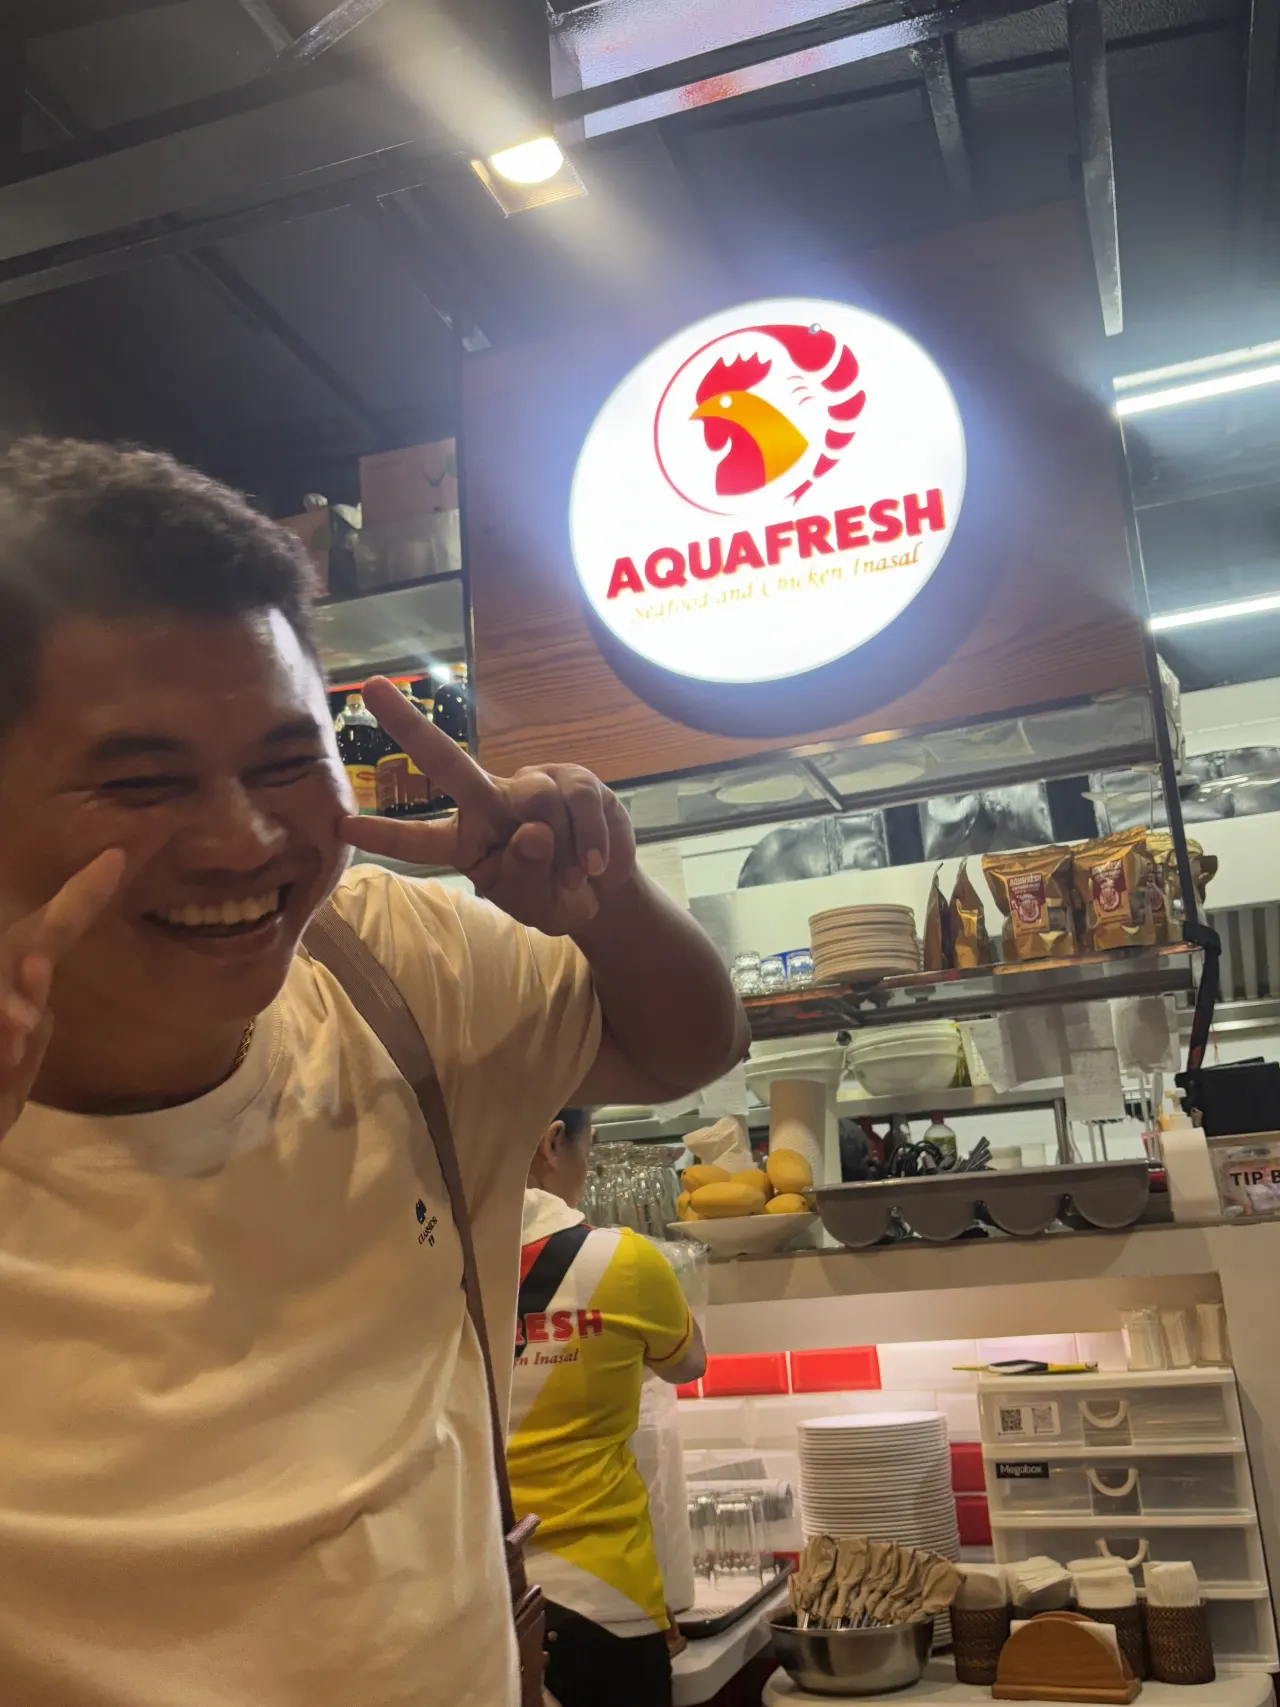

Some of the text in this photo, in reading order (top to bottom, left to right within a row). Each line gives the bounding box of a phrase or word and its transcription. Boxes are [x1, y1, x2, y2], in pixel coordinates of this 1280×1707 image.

[607, 488, 946, 599] AQUAFRESH
[853, 541, 922, 576] Inasal
[1229, 1171, 1263, 1187] TIP
[533, 1348, 579, 1365] Inasal
